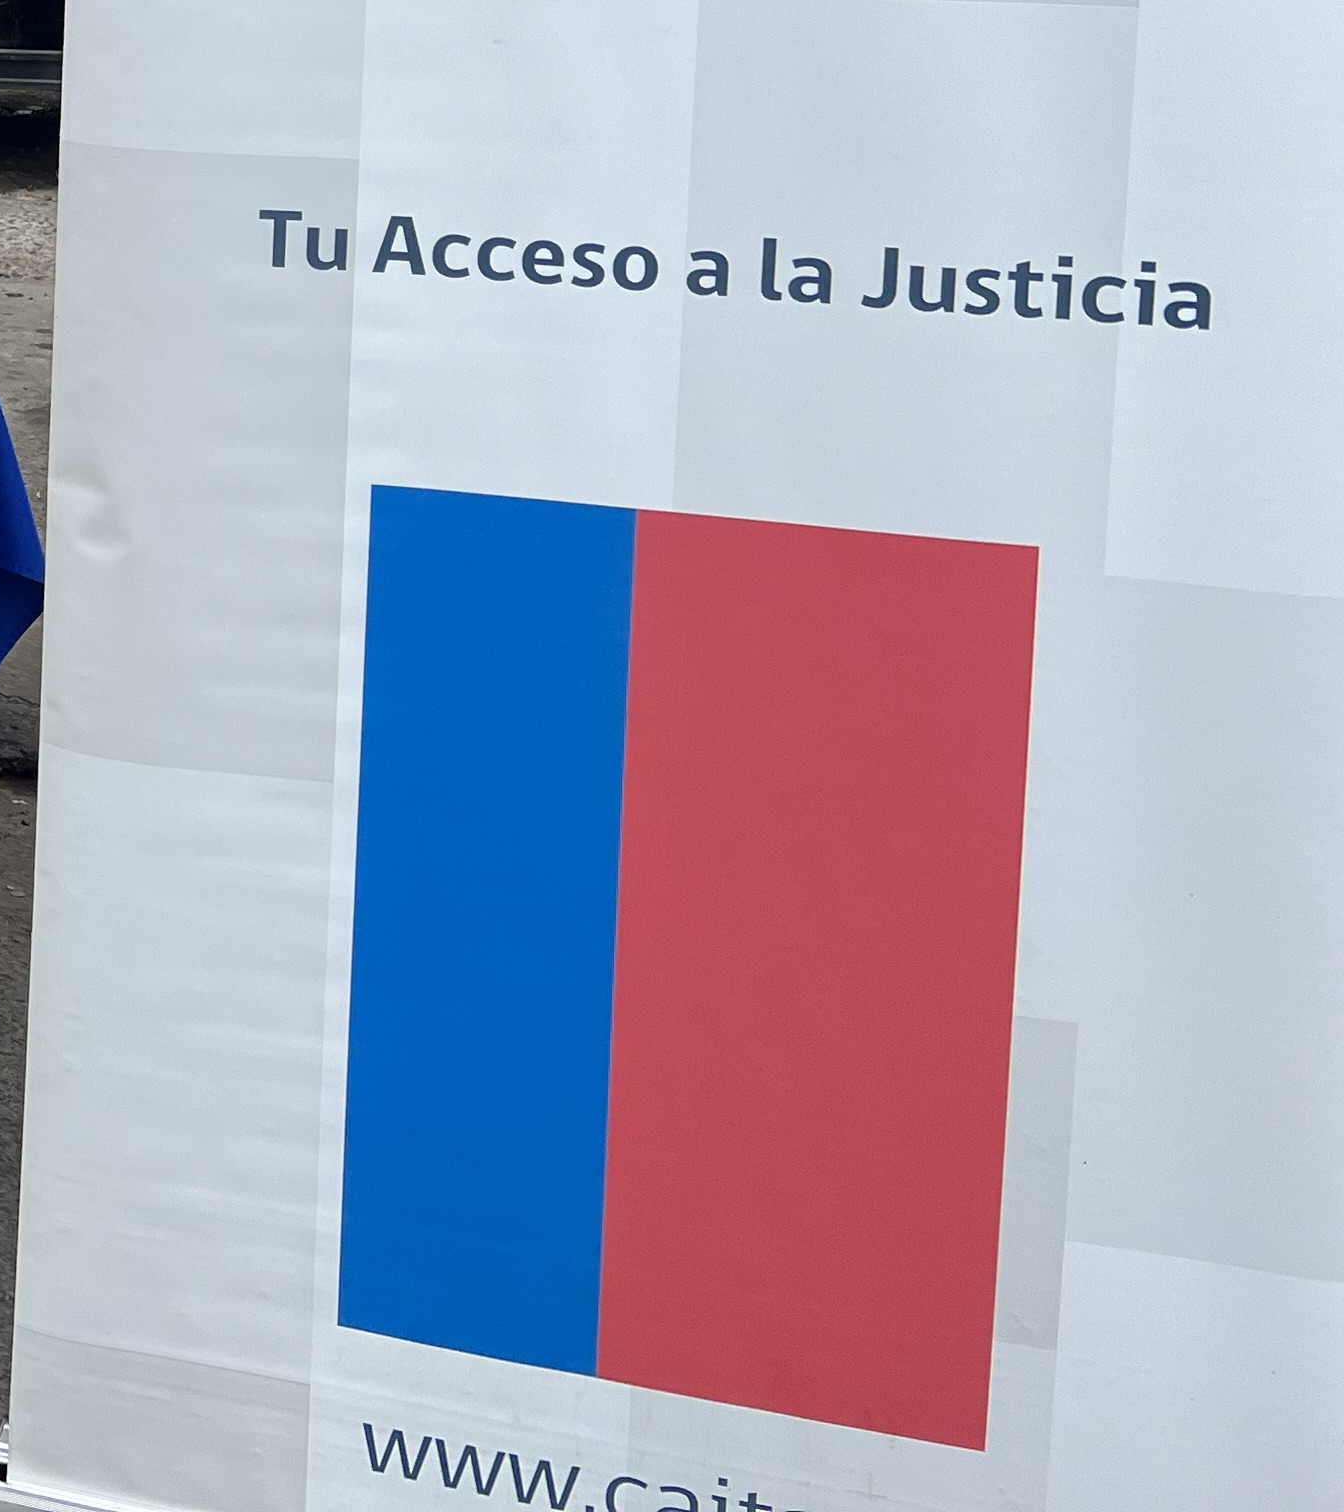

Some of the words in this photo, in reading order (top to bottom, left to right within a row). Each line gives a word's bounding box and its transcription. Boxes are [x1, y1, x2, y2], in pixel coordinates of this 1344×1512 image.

[258, 208, 348, 272] Tu
[371, 215, 660, 293] Acceso
[685, 245, 731, 297] a
[760, 238, 832, 304] la
[861, 246, 1213, 331] Justicia
